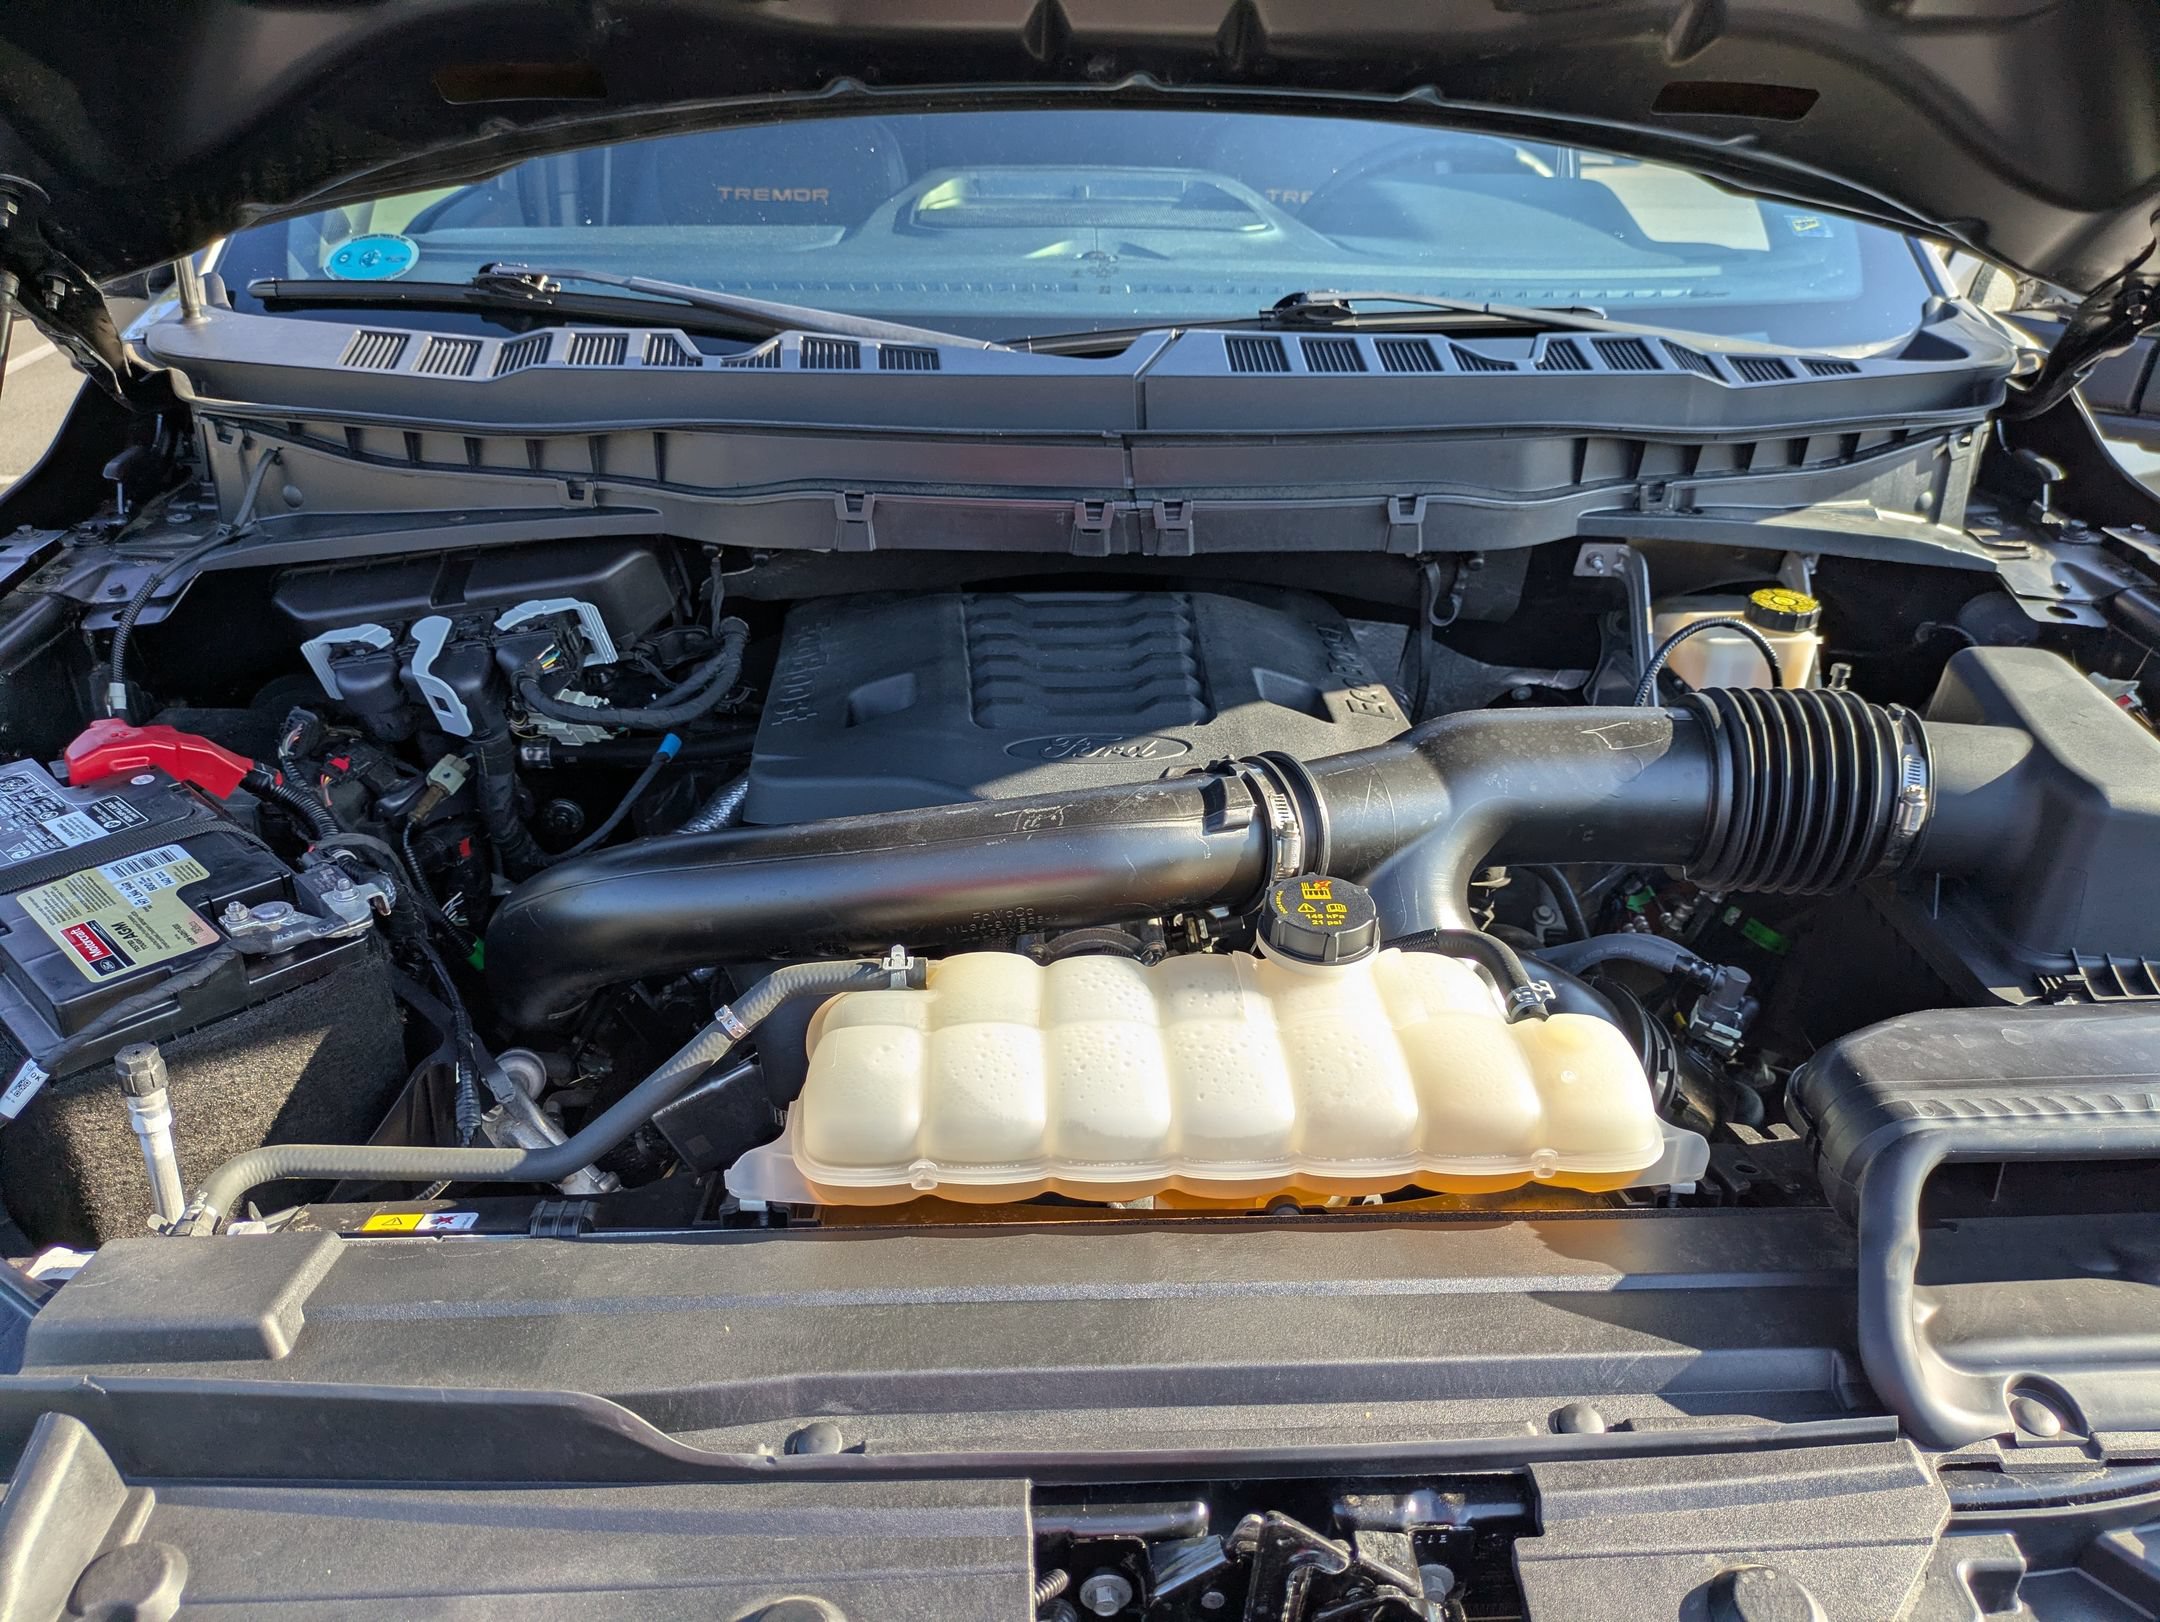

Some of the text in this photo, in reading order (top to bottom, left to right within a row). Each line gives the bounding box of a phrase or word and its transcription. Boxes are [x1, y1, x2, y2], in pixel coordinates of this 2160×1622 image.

[718, 187, 829, 202] TREMOR
[1040, 736, 1157, 760] Ford
[110, 920, 137, 940] AGM
[68, 927, 104, 957] Motorcraft
[126, 939, 142, 952] TESTED
[31, 1072, 43, 1082] OK
